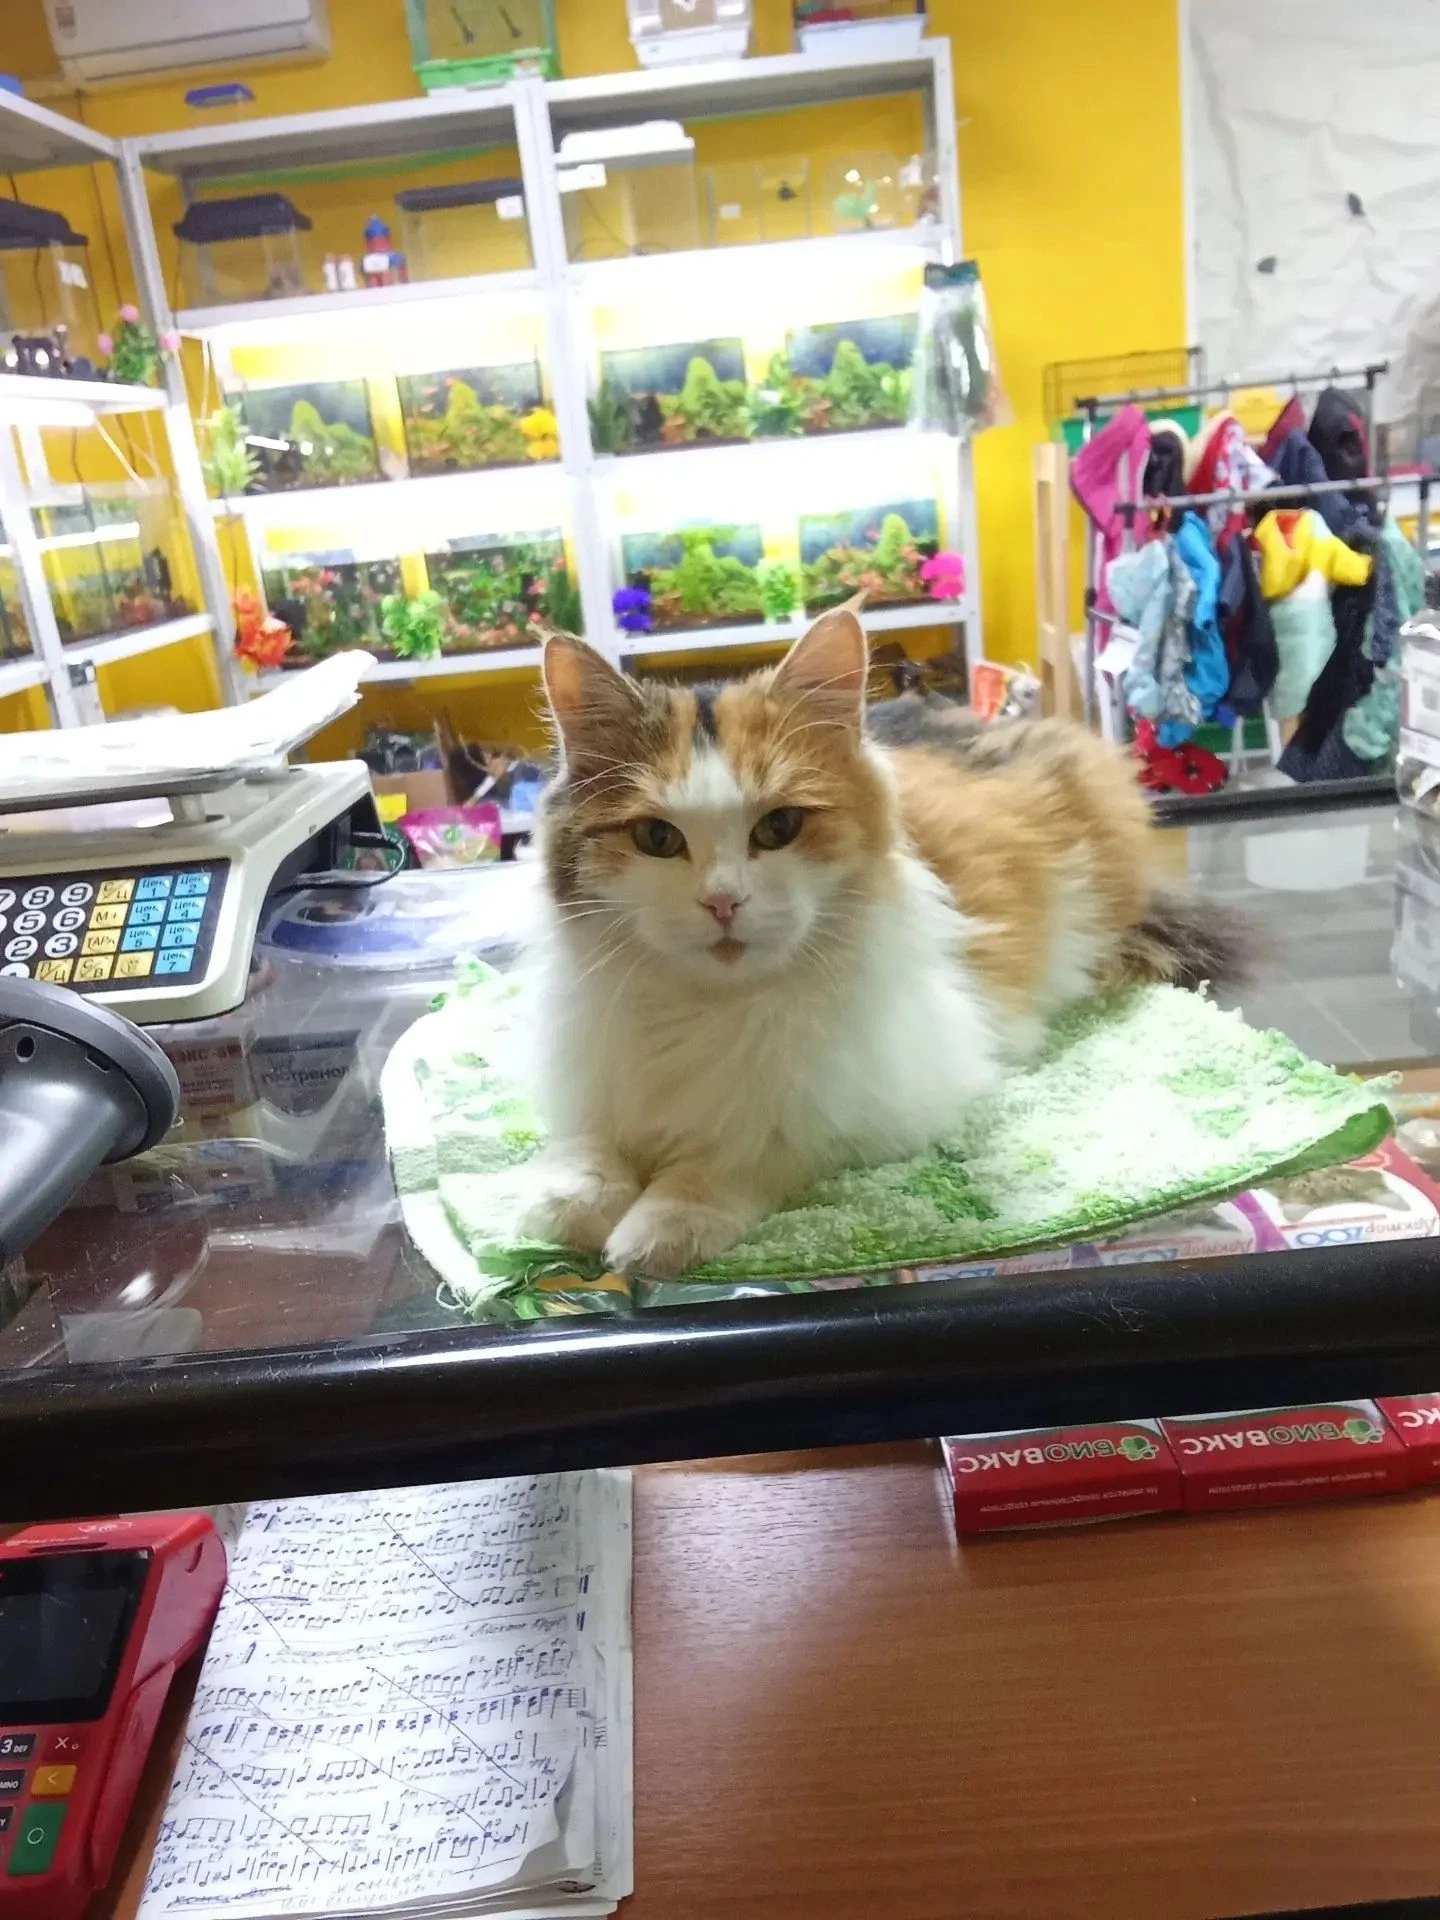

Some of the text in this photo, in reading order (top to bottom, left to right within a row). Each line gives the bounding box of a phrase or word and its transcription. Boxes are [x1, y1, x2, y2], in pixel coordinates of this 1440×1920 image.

[29, 890, 49, 905] 8
[67, 886, 88, 902] 9
[20, 914, 40, 930] 5
[60, 911, 79, 927] 6
[11, 940, 32, 957] 2
[51, 937, 72, 953] 3
[168, 961, 176, 970] 7
[1180, 1422, 1343, 1455] БИОВАКС
[959, 1438, 1116, 1473] БИОВАКС
[1, 1739, 28, 1753] 3 DEF
